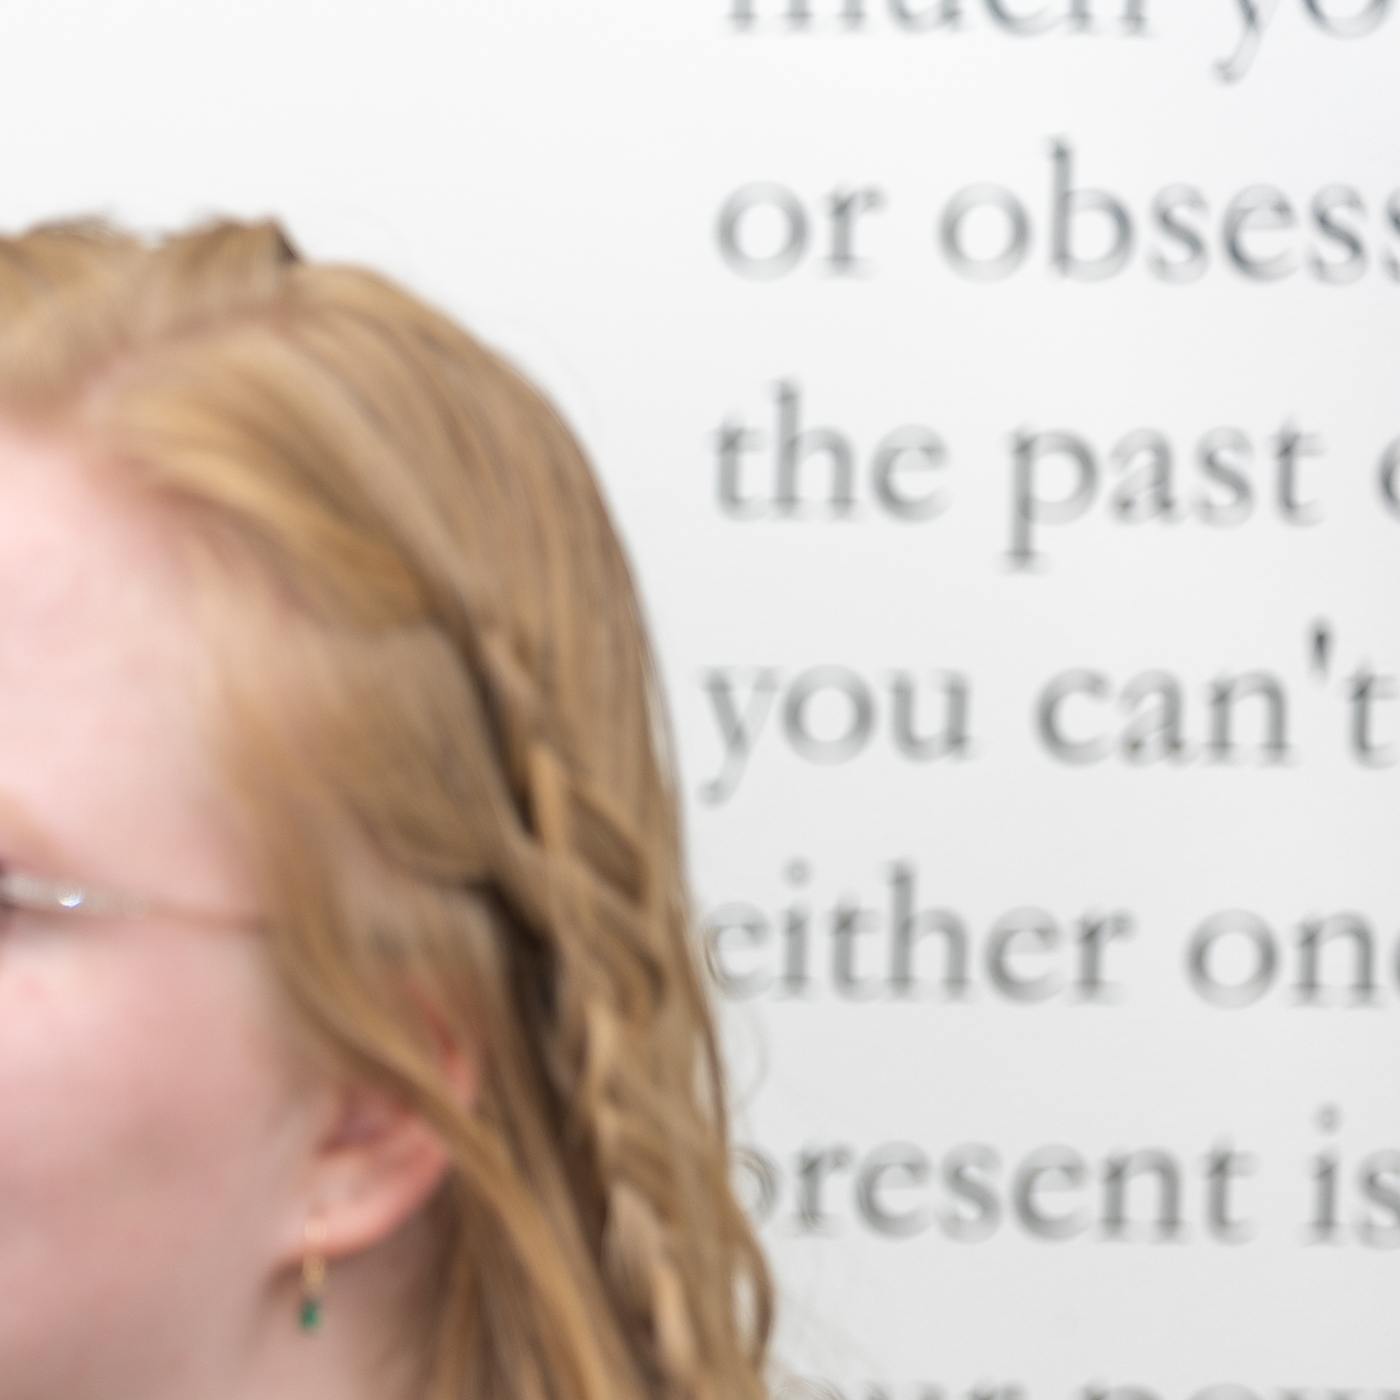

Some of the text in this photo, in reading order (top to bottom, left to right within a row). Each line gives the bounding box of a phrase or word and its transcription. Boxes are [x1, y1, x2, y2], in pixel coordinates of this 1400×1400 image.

[713, 179, 886, 283] or
[708, 373, 954, 524] the
[998, 412, 1327, 574] past
[698, 614, 1400, 806] you can't
[703, 856, 1136, 1006] either
